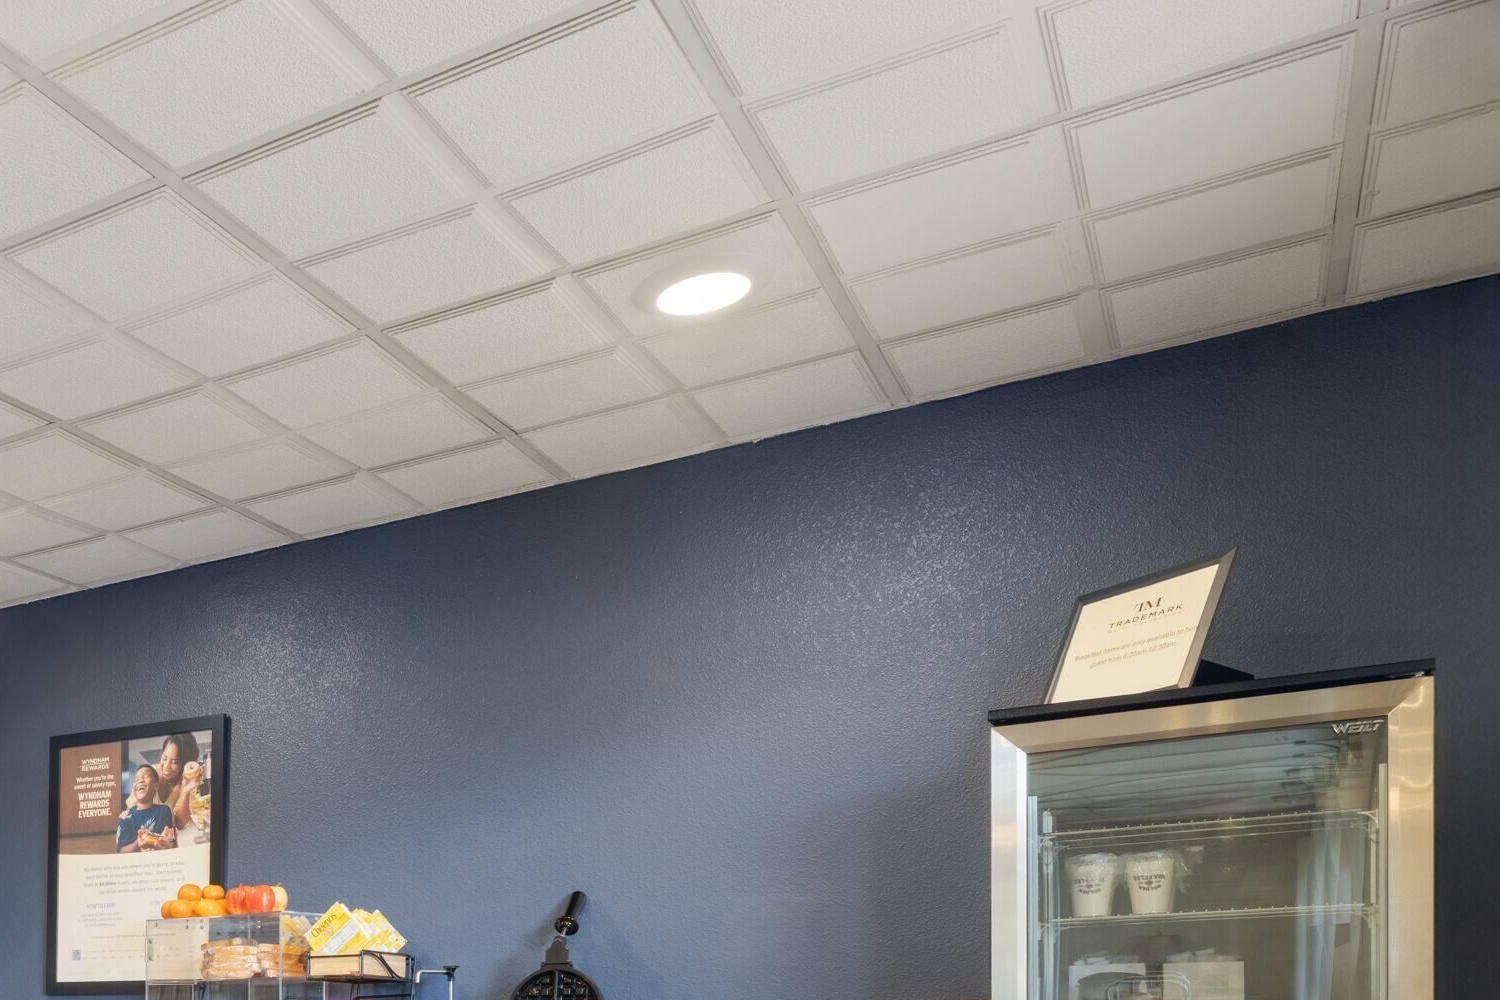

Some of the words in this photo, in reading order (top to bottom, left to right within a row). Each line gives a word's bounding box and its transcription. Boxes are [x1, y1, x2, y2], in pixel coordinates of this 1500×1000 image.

[1108, 603, 1184, 629] TRADEMARK
[81, 756, 110, 765] WYNDHAM
[81, 763, 109, 772] REWARDS
[78, 790, 112, 801] WYNDHAM
[79, 799, 110, 810] REWARDS
[78, 807, 112, 818] EVERYONE.
